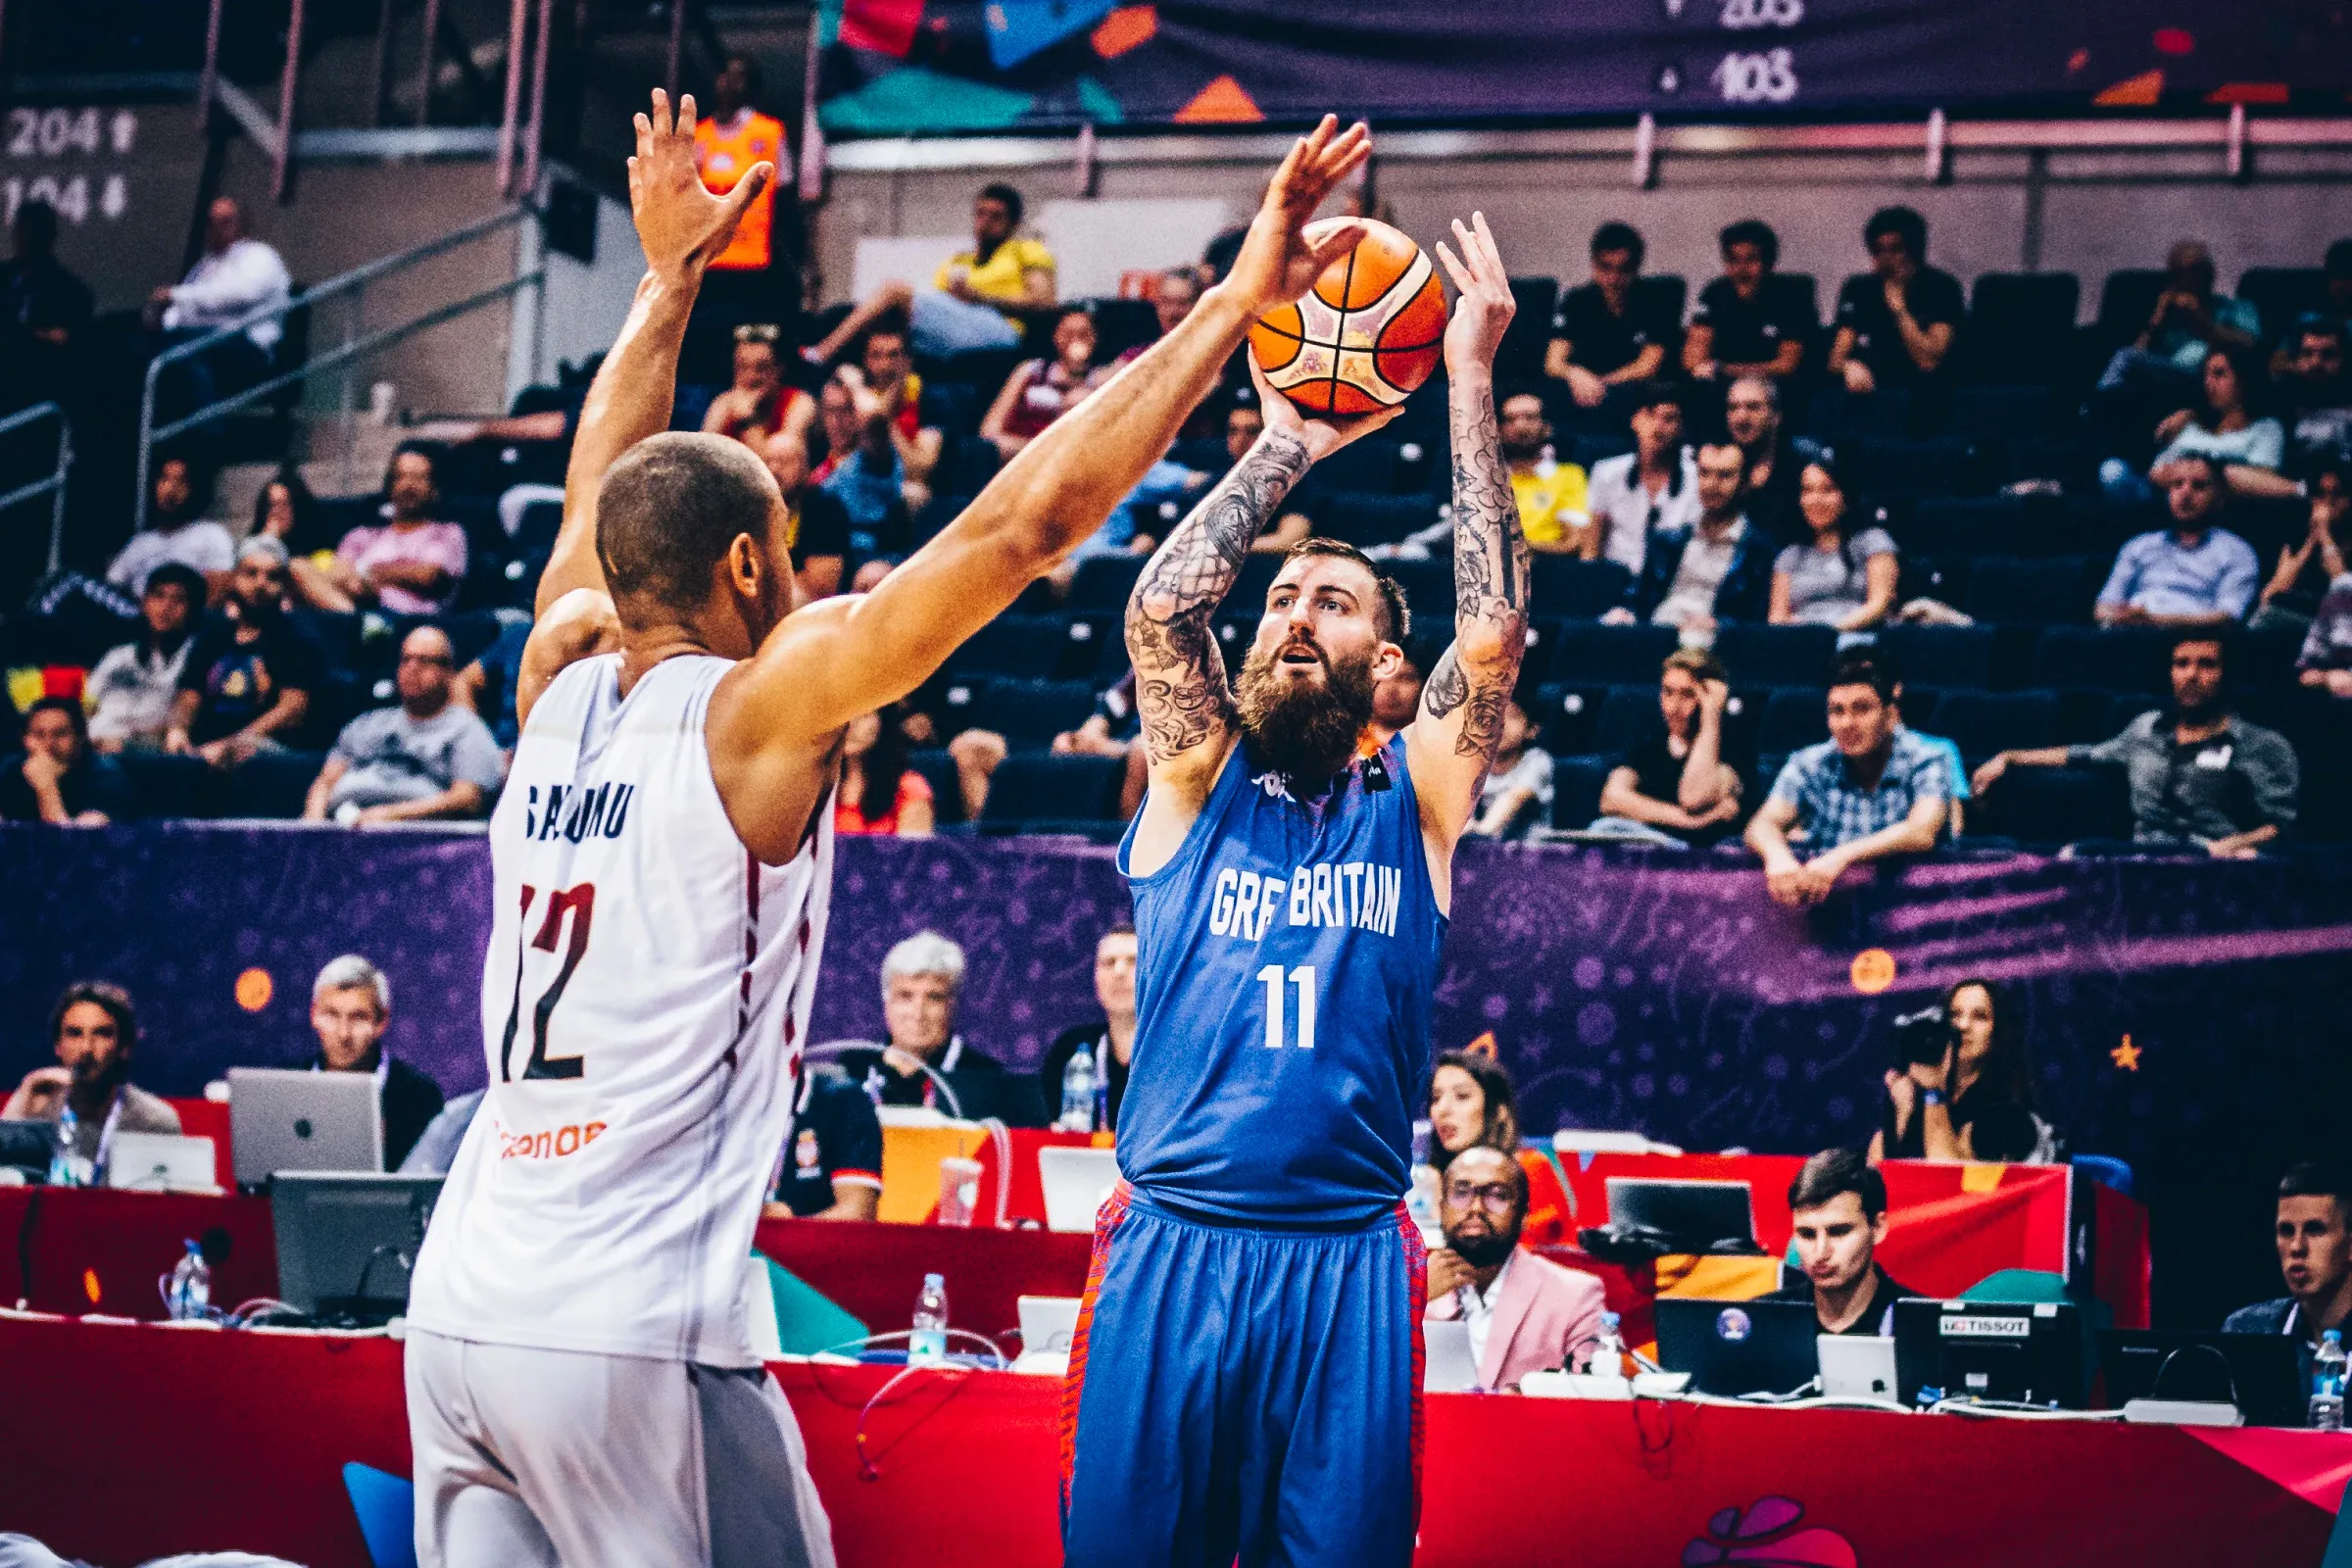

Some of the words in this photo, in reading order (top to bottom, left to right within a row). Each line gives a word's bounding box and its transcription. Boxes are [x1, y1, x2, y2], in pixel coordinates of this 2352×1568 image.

[1712, 49, 1798, 102] 103
[8, 108, 99, 155] 204
[1289, 861, 1401, 938] BRITAIN
[501, 881, 596, 1083] 12
[1256, 964, 1315, 1049] 11
[1970, 1320, 2024, 1333] TISSOT
